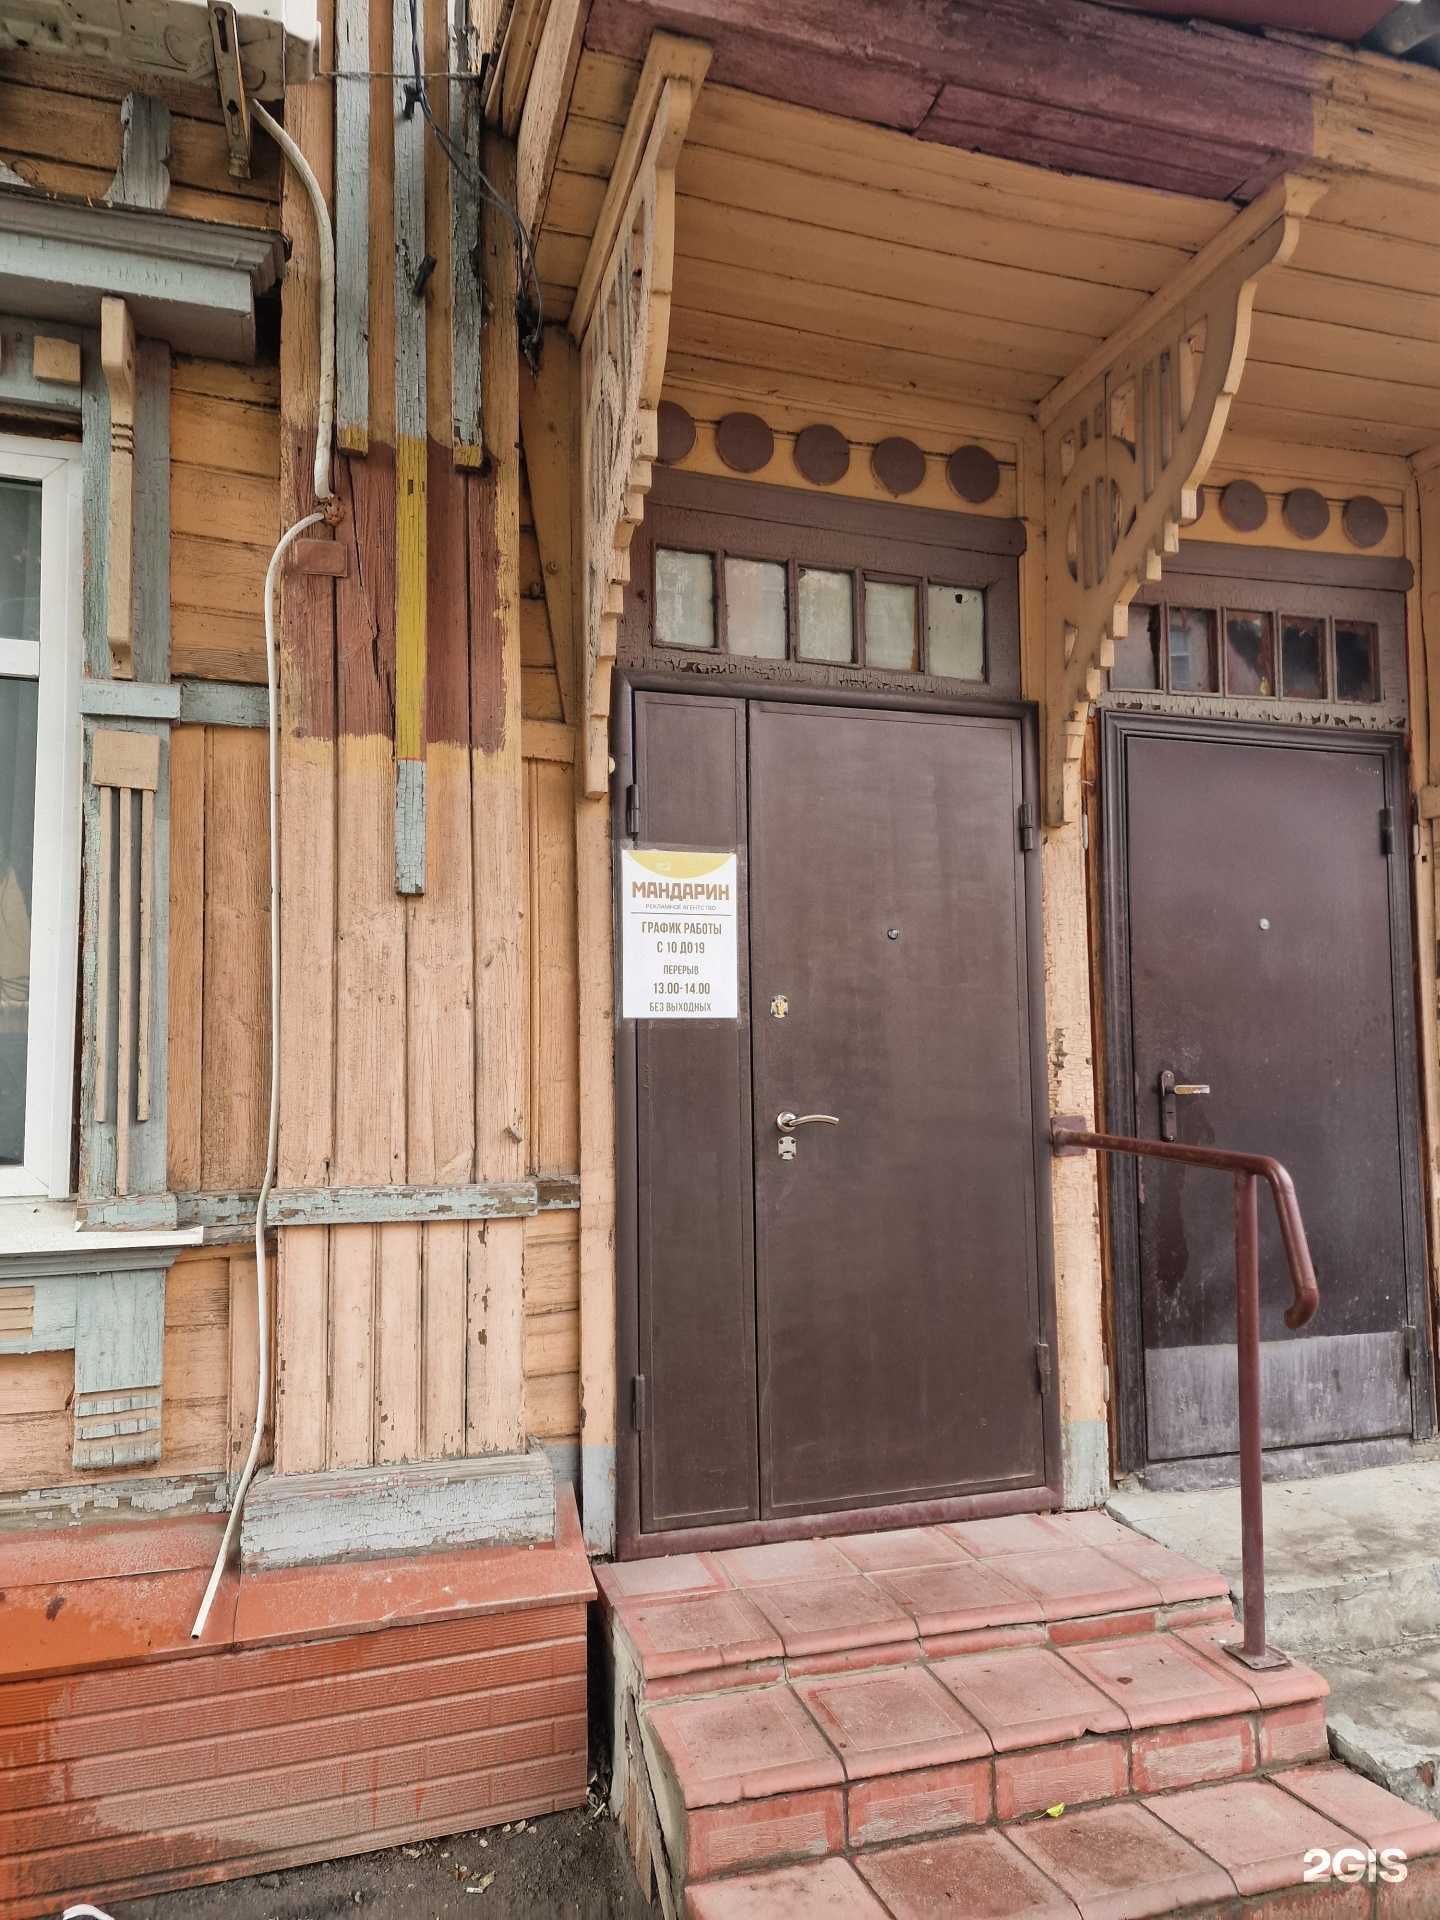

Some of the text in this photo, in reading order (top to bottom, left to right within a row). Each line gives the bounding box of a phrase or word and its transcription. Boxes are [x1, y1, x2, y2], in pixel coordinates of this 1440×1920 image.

[632, 881, 729, 901] МАНДАРИН
[641, 921, 722, 935] ГРАФИК РАБОТЫ
[656, 940, 663, 953] С
[666, 941, 678, 953] 10
[663, 964, 700, 975] ПЕРЕРЫВ
[653, 982, 711, 994] 13.00-14.00
[649, 1001, 712, 1013] БЕЗ ВЫХОДНЫХ
